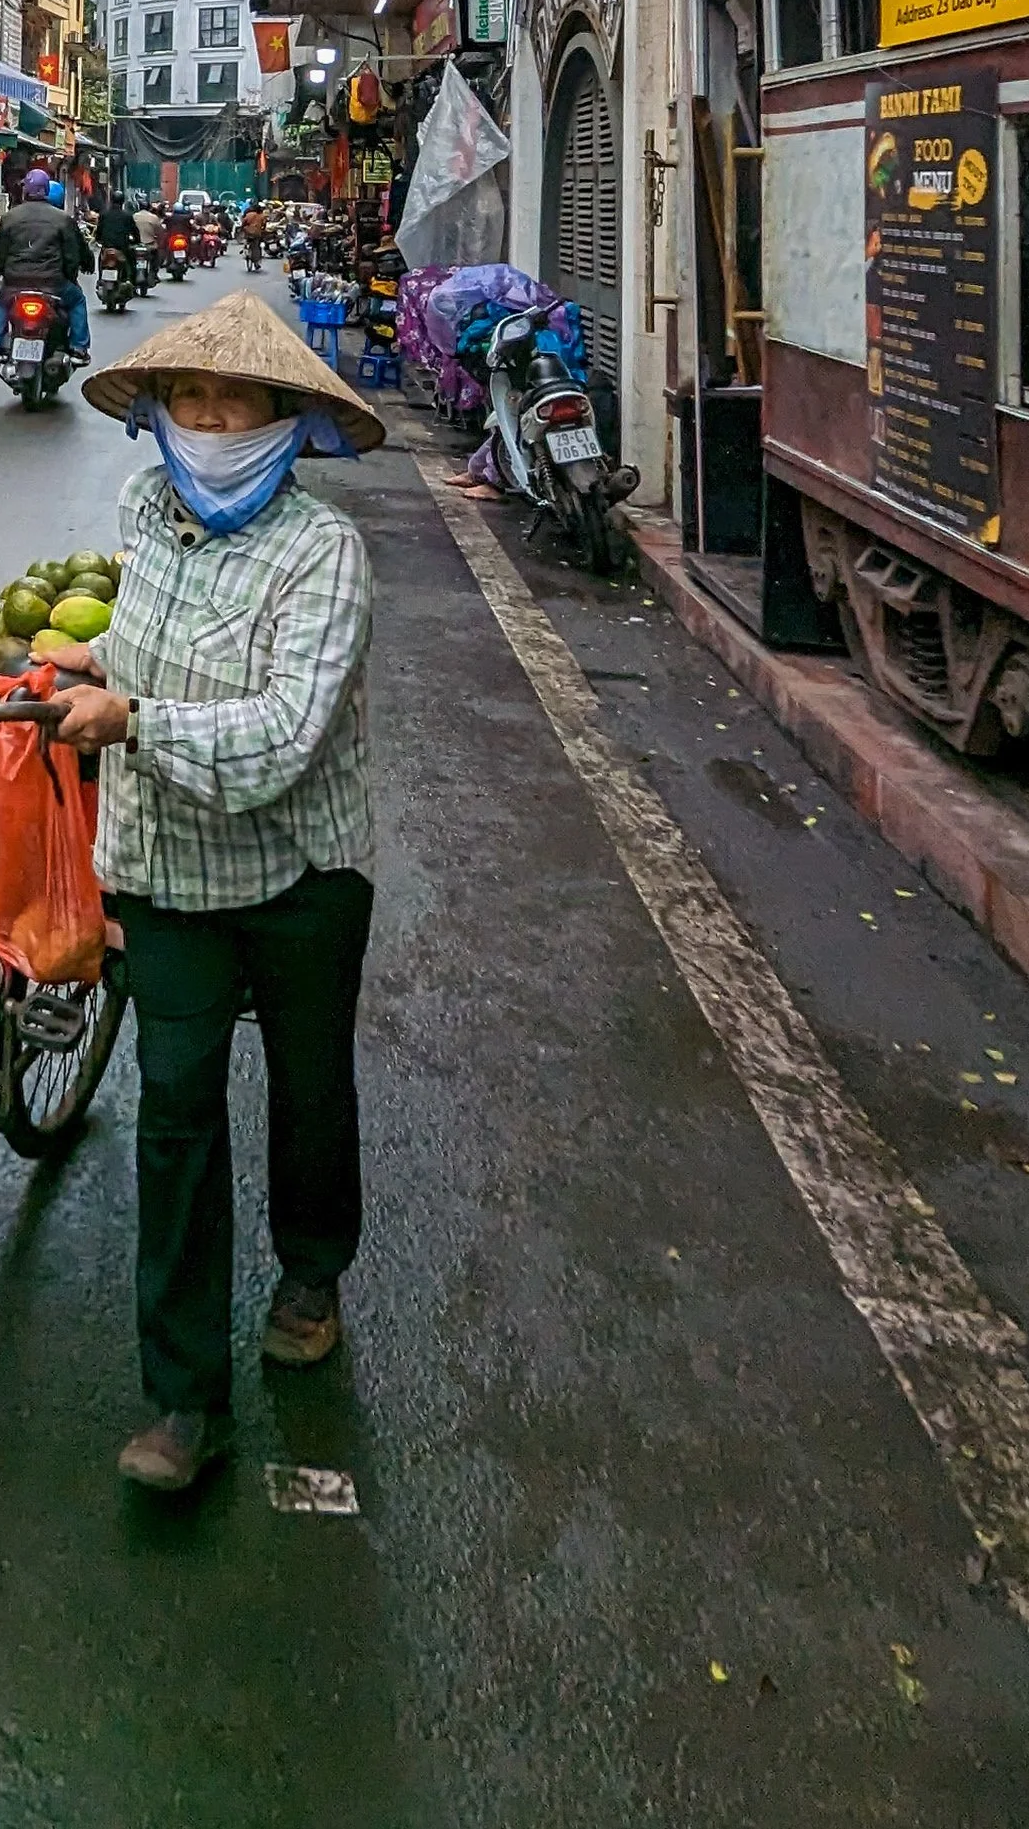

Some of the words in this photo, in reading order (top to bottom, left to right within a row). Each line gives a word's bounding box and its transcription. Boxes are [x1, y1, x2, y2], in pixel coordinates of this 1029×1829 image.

[914, 138, 954, 162] FOOD
[912, 170, 954, 194] MENU
[555, 442, 598, 460] 706.18
